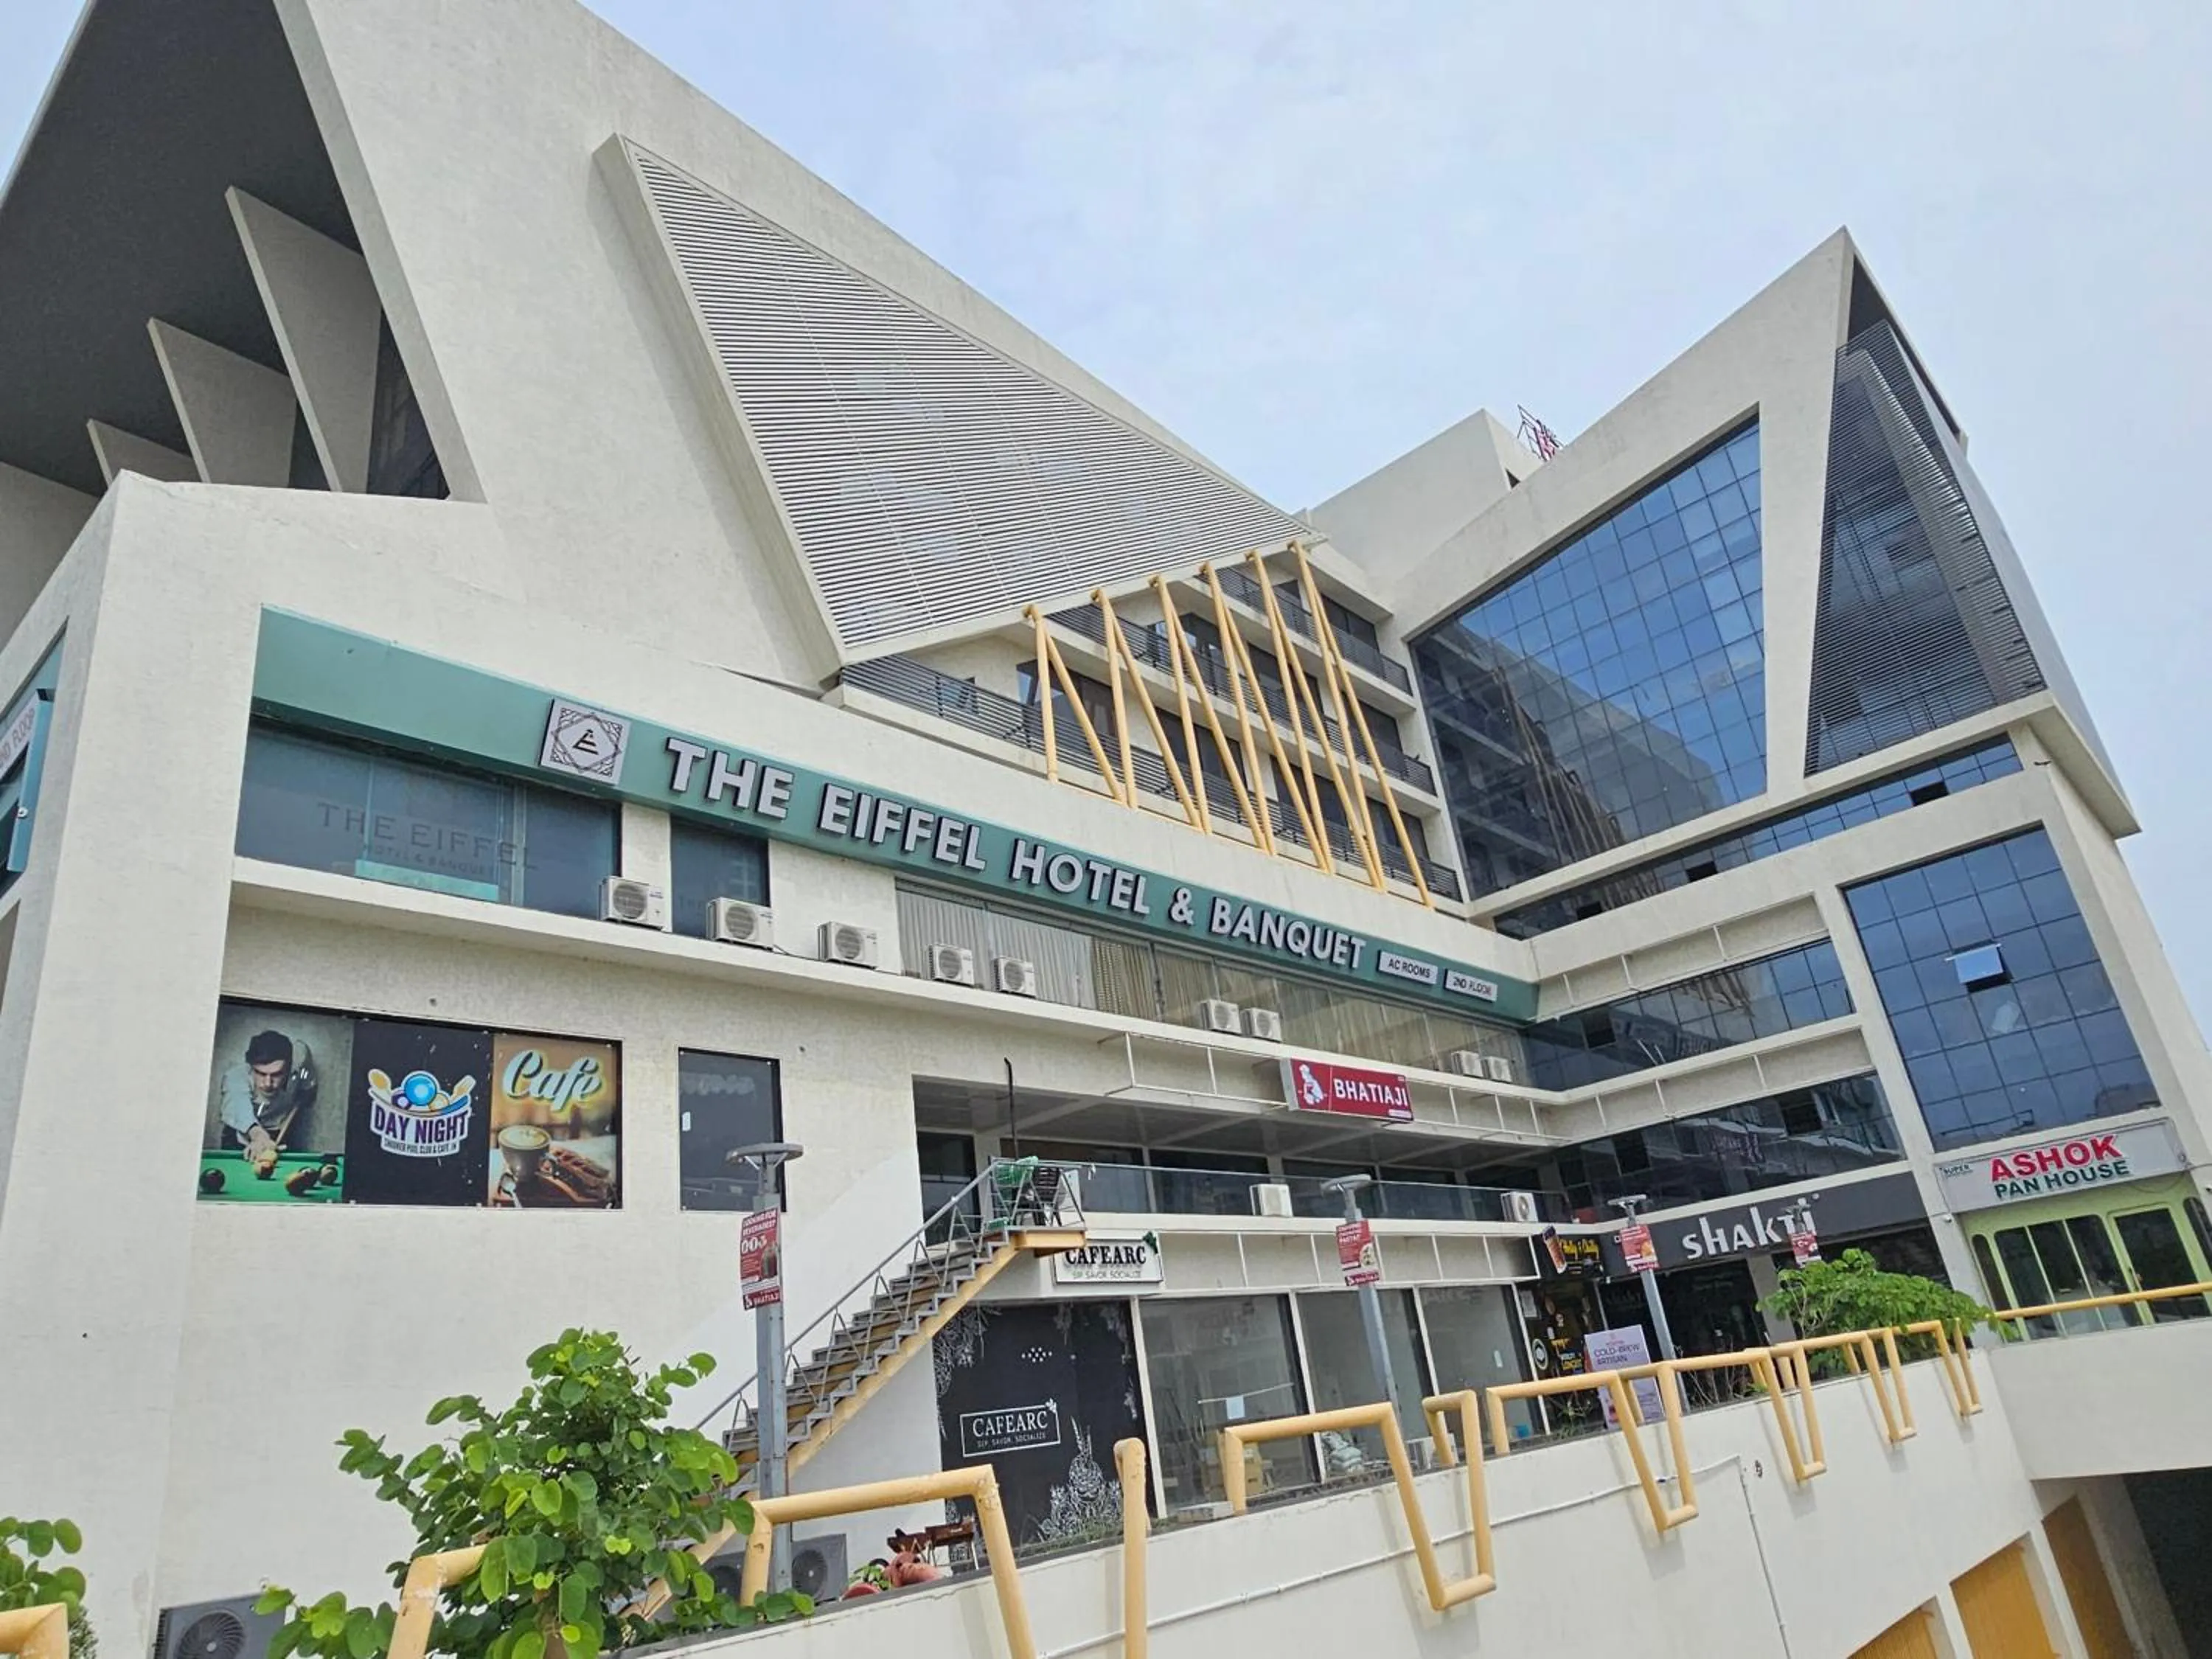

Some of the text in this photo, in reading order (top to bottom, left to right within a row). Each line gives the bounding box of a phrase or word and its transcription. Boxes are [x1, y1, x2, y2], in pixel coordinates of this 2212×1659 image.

[317, 801, 539, 871] THE EIFFEL
[667, 737, 1367, 970] THE EIFFEL HOTEL & BANQUET
[1388, 958, 1430, 978] AC ROOMS
[1333, 1077, 1408, 1107] BHATIAJI
[374, 1106, 470, 1144] DAY NIGHT
[1990, 1134, 2124, 1182] ASHOK
[1993, 1160, 2130, 1200] PAN HOUSE
[1065, 1245, 1147, 1265] CAFEARC
[973, 1411, 1048, 1437] CAFEARC
